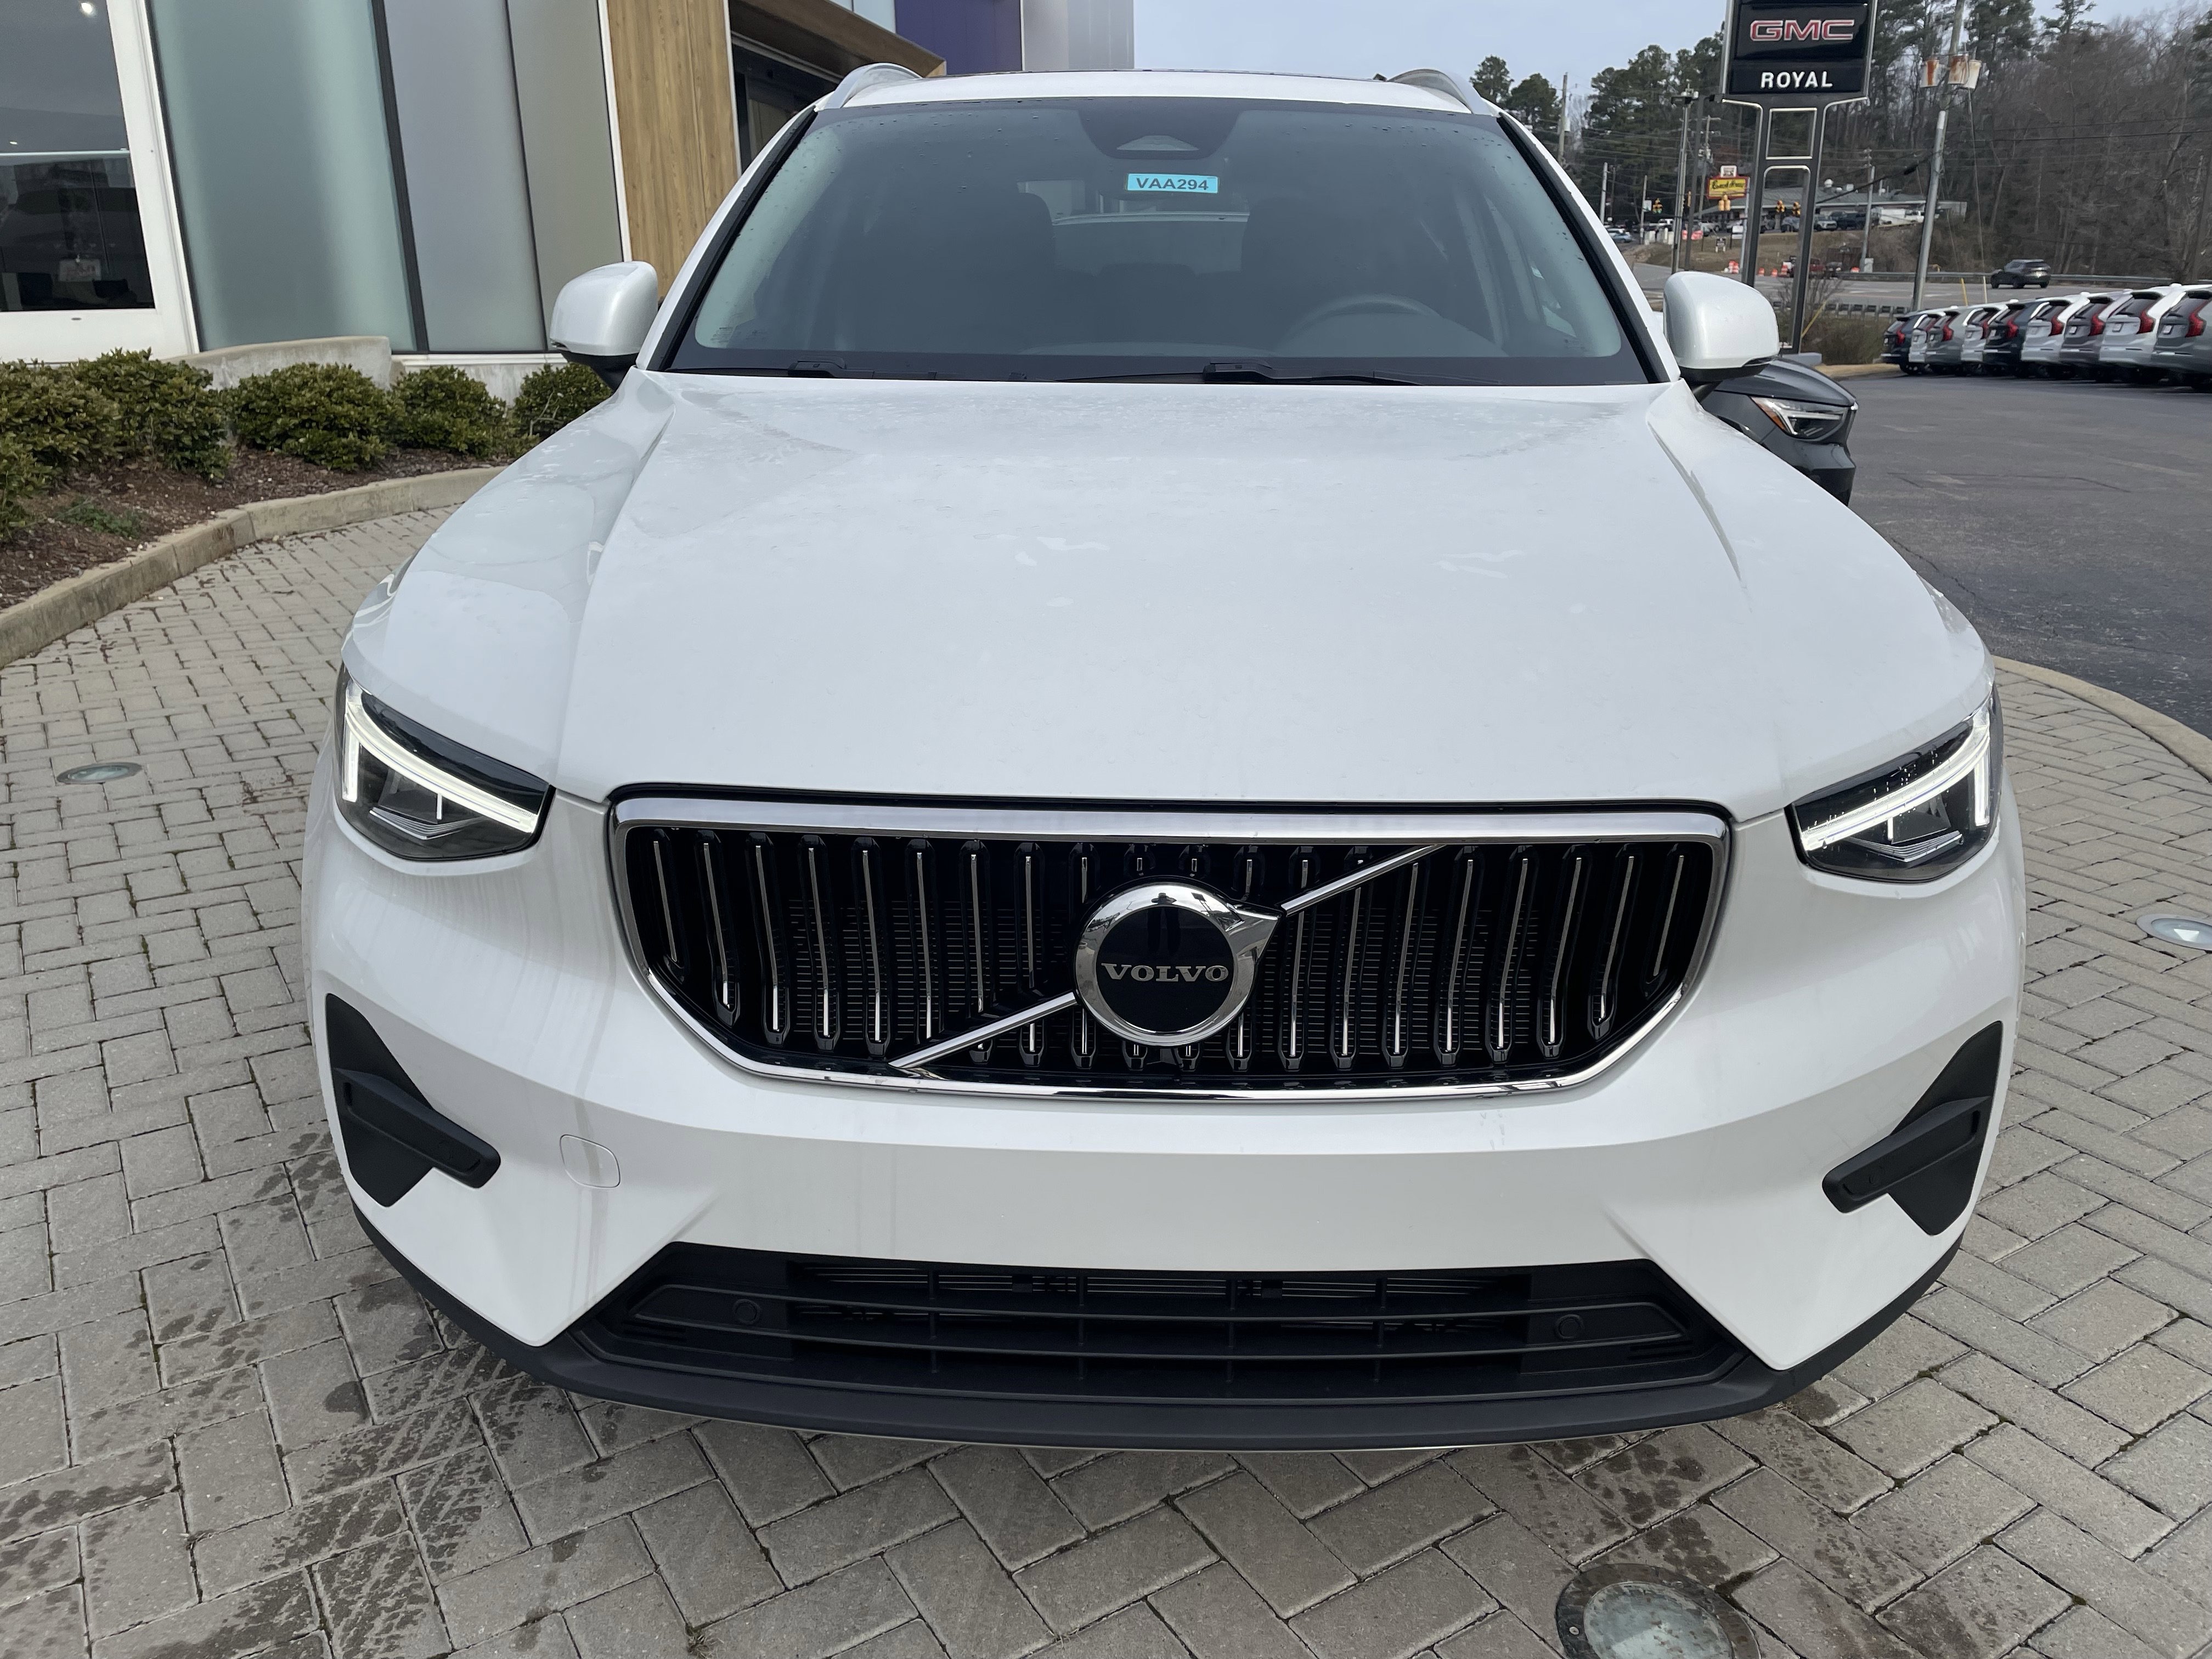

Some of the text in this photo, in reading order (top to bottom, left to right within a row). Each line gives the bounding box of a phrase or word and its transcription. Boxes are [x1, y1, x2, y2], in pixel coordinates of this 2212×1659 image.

[1750, 20, 1854, 41] GMC
[1760, 71, 1833, 88] ROYAL
[1136, 177, 1209, 190] VAA294
[1101, 963, 1229, 982] VOLVO
